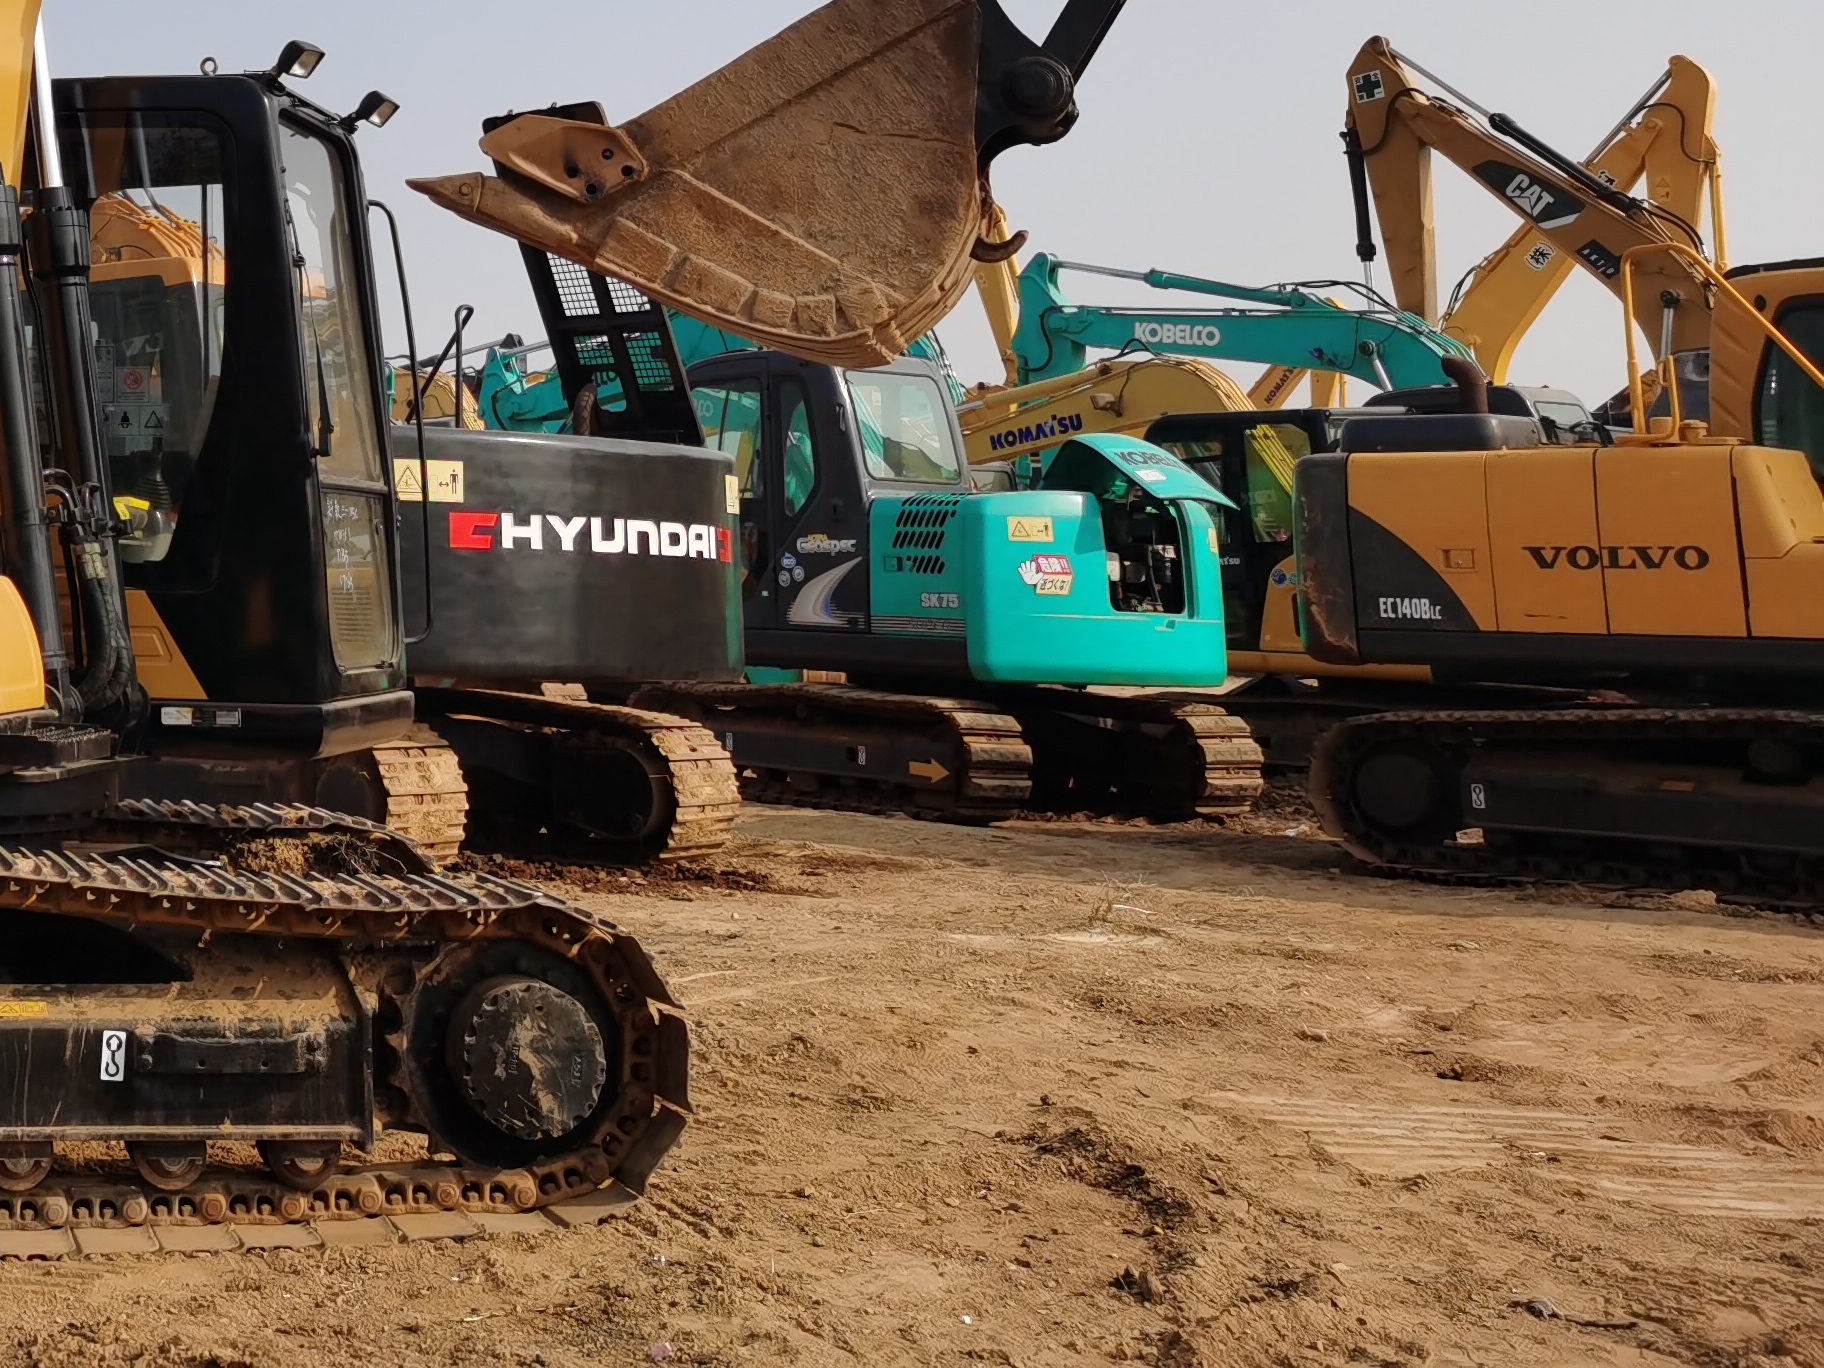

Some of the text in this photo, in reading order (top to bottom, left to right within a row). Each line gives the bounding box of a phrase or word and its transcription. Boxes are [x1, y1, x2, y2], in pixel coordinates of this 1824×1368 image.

[1505, 173, 1555, 217] CAT
[1133, 322, 1221, 347] KOBELCO
[989, 413, 1083, 451] KOMATSU
[501, 512, 717, 560] HYUNDAI
[1522, 545, 1710, 570] VOLVO
[920, 592, 959, 609] SK75
